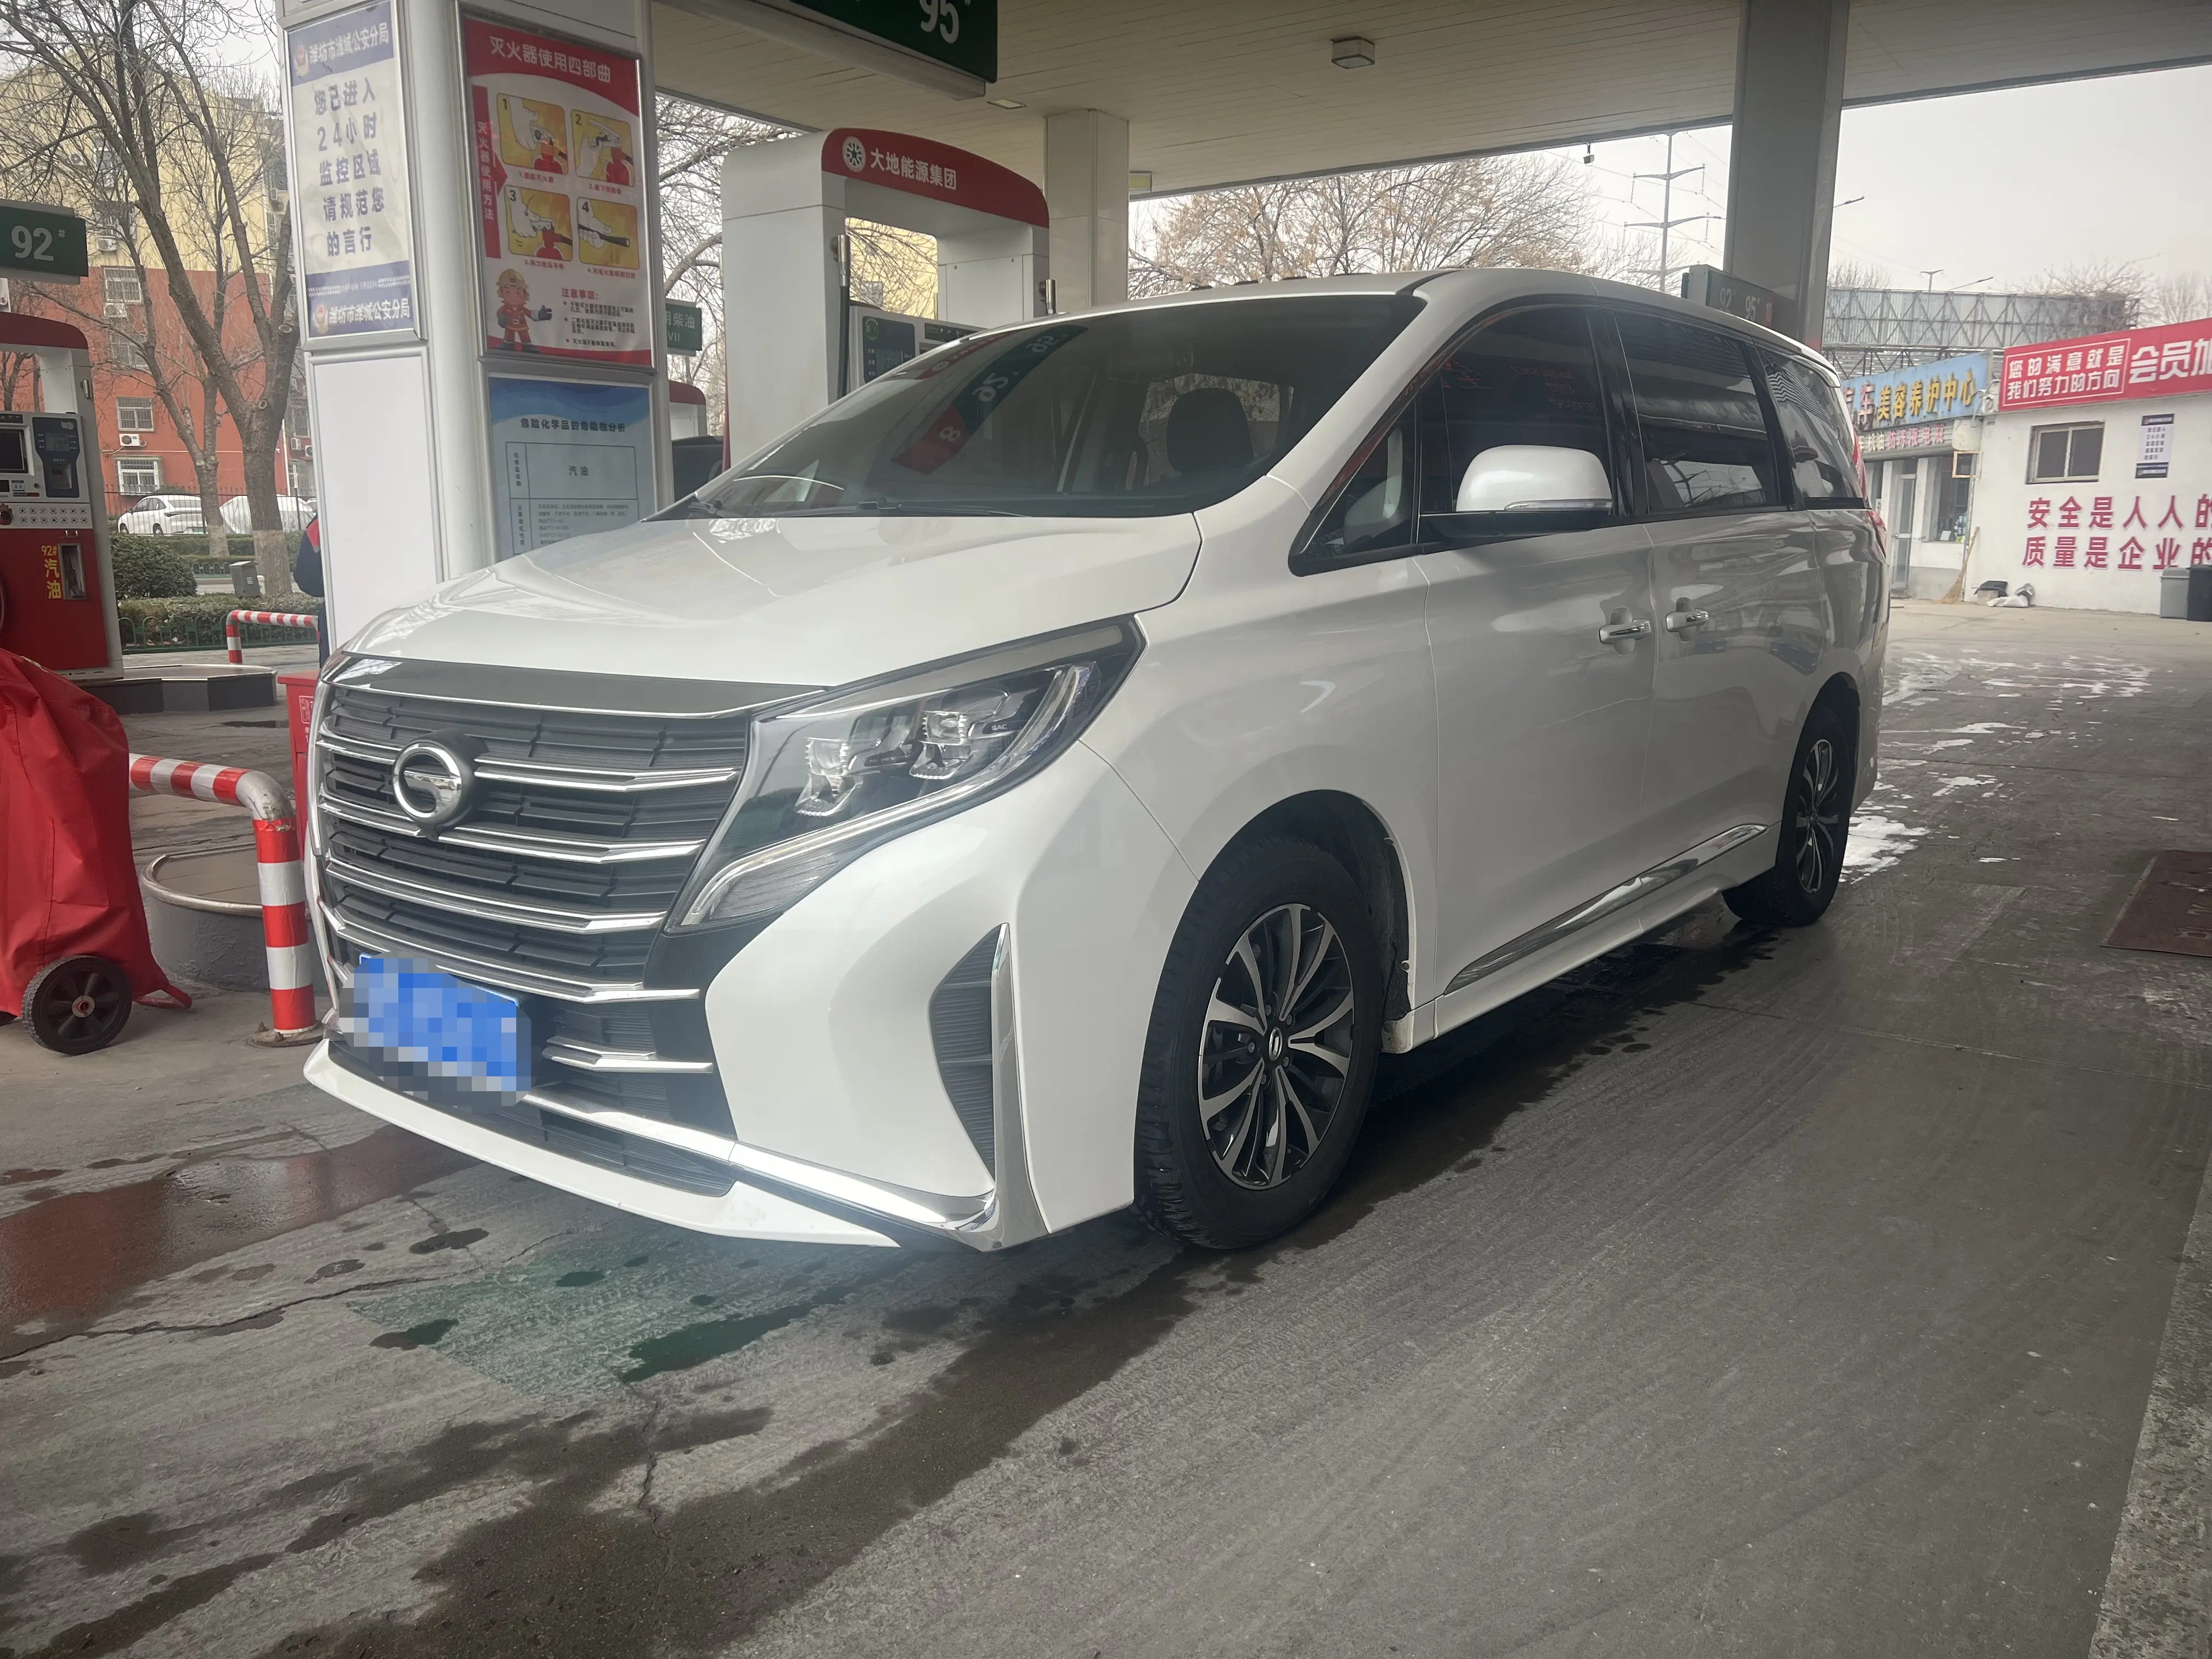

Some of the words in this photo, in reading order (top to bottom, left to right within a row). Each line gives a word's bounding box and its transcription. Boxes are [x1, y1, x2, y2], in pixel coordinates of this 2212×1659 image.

[309, 22, 389, 64] 潍坊市潍城公安分局
[489, 36, 611, 83] 灭火器使用四部曲
[314, 77, 376, 115] 您已进入
[502, 98, 508, 110] 1
[318, 112, 377, 152] 24小时
[575, 114, 582, 126] 2
[319, 149, 381, 187] 监控区域
[477, 121, 495, 221] 灭火器使用方法
[871, 148, 957, 191] 大地能源集团
[323, 187, 385, 222] 请规范您
[509, 190, 516, 202] 3
[582, 201, 589, 213] 4
[327, 227, 373, 257] 的言行
[329, 298, 410, 324] 潍坊市潍城公安分局
[2008, 345, 2125, 380] 您的满意就是
[2007, 369, 2121, 400] 我们努力的方向
[521, 418, 627, 433] 危险化学品的危险性分析
[568, 465, 589, 477] 汽油
[42, 545, 58, 557] 92#
[44, 558, 62, 600] 汽油
